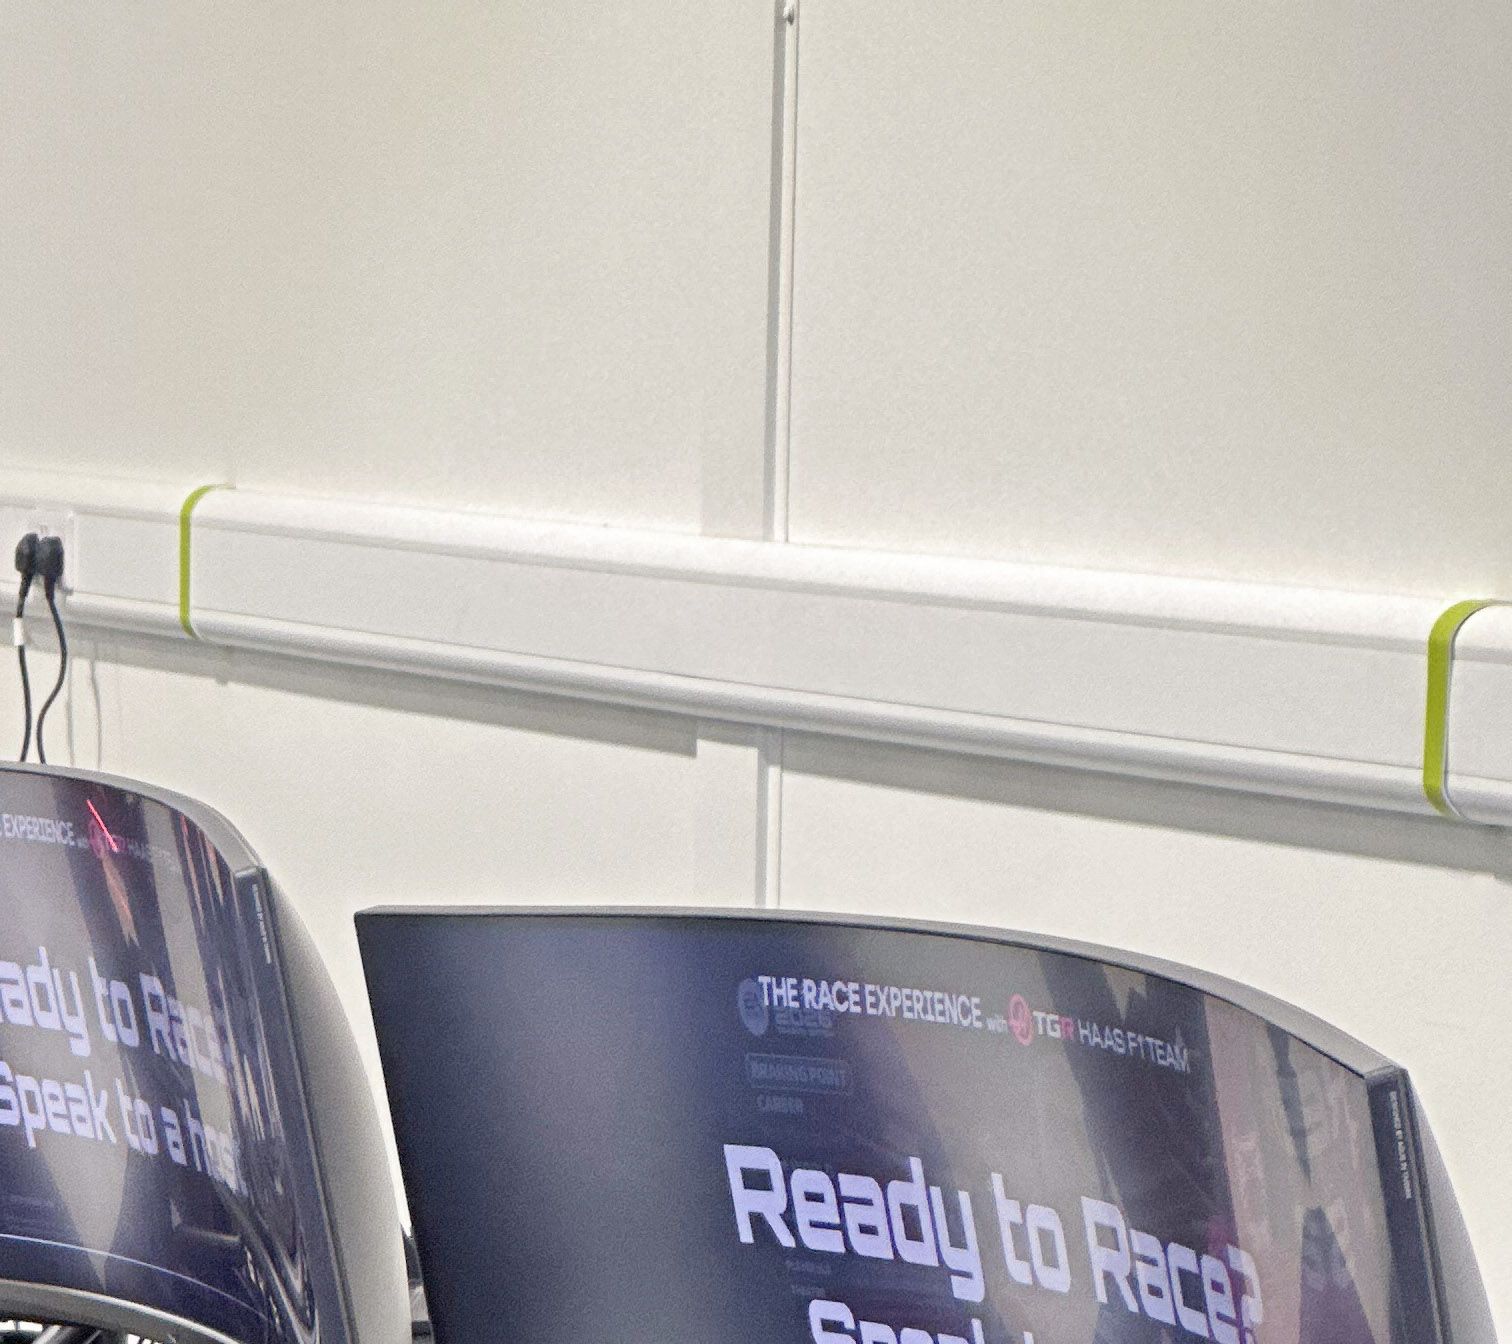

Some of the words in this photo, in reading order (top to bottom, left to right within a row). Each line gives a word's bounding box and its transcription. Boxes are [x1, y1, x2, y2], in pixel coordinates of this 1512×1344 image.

[2, 813, 77, 847] EXPERIENCE
[88, 956, 139, 1048] to
[758, 975, 800, 1009] THE
[802, 980, 862, 1014] RACE
[865, 984, 983, 1030] EXPERIENCE
[1032, 1010, 1076, 1041] TGR
[1077, 1023, 1126, 1057] HAAS
[1143, 1035, 1191, 1075] TEAM
[115, 1078, 158, 1155] to
[160, 1106, 188, 1167] a
[723, 1143, 985, 1302] Ready
[990, 1172, 1072, 1294] to
